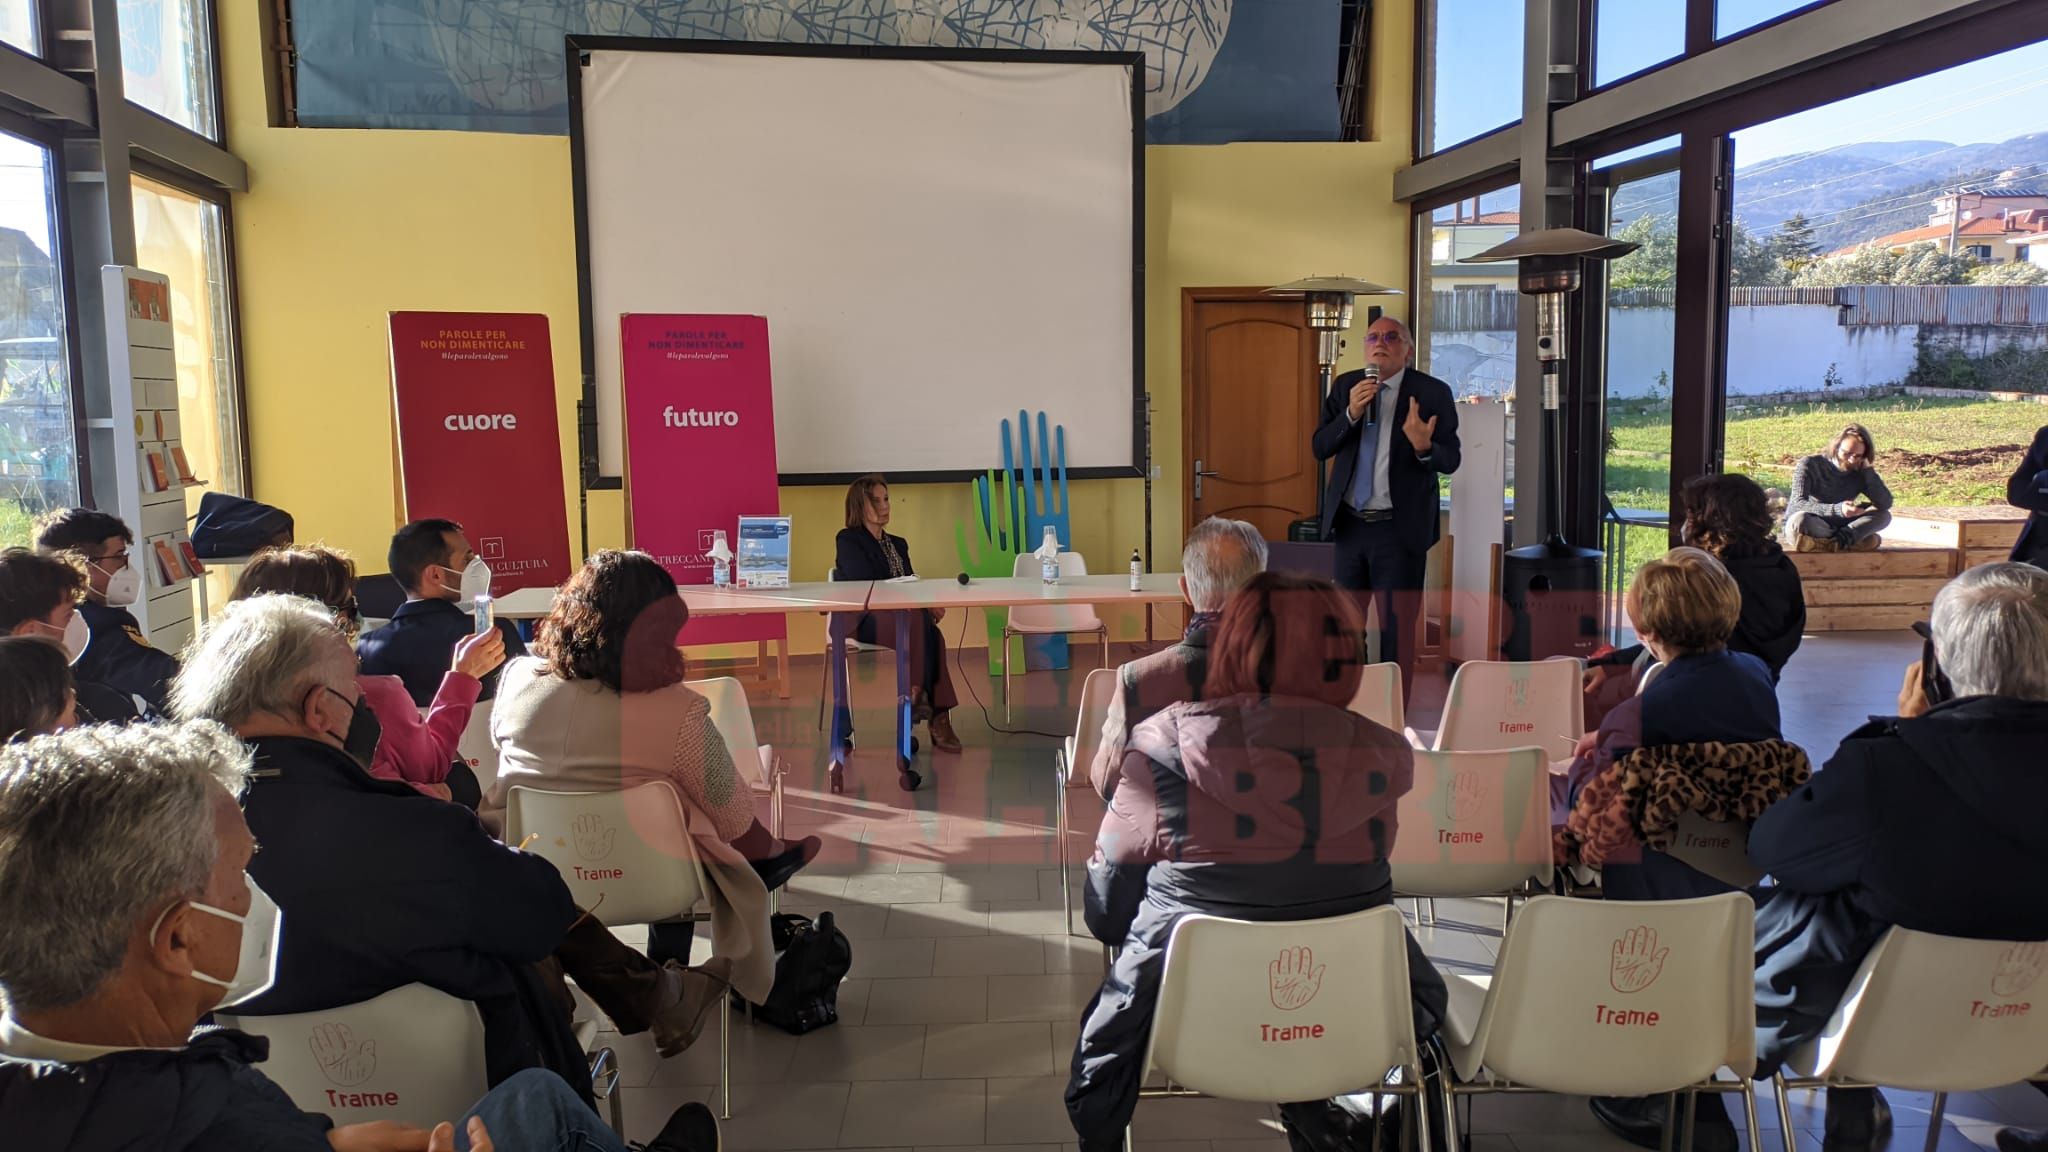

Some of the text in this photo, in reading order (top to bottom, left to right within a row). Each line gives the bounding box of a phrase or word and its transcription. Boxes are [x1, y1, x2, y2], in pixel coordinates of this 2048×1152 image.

[440, 330, 506, 340] PAROLE PER
[665, 331, 704, 339] PAROLE
[420, 340, 526, 350] NON DIMENTICARE
[648, 341, 745, 350] NON DIMENTICARE
[444, 413, 517, 431] cuore
[663, 405, 739, 427] futuro
[496, 559, 549, 571] CULTURA
[1498, 721, 1534, 734] Trame
[1438, 829, 1484, 845] Trame
[1686, 833, 1730, 849] Trame
[573, 866, 623, 881] Trame
[1597, 1005, 1659, 1026] Trame
[1971, 1001, 2031, 1018] Trame
[1260, 1024, 1324, 1041] Trame
[325, 1089, 398, 1107] Trame
